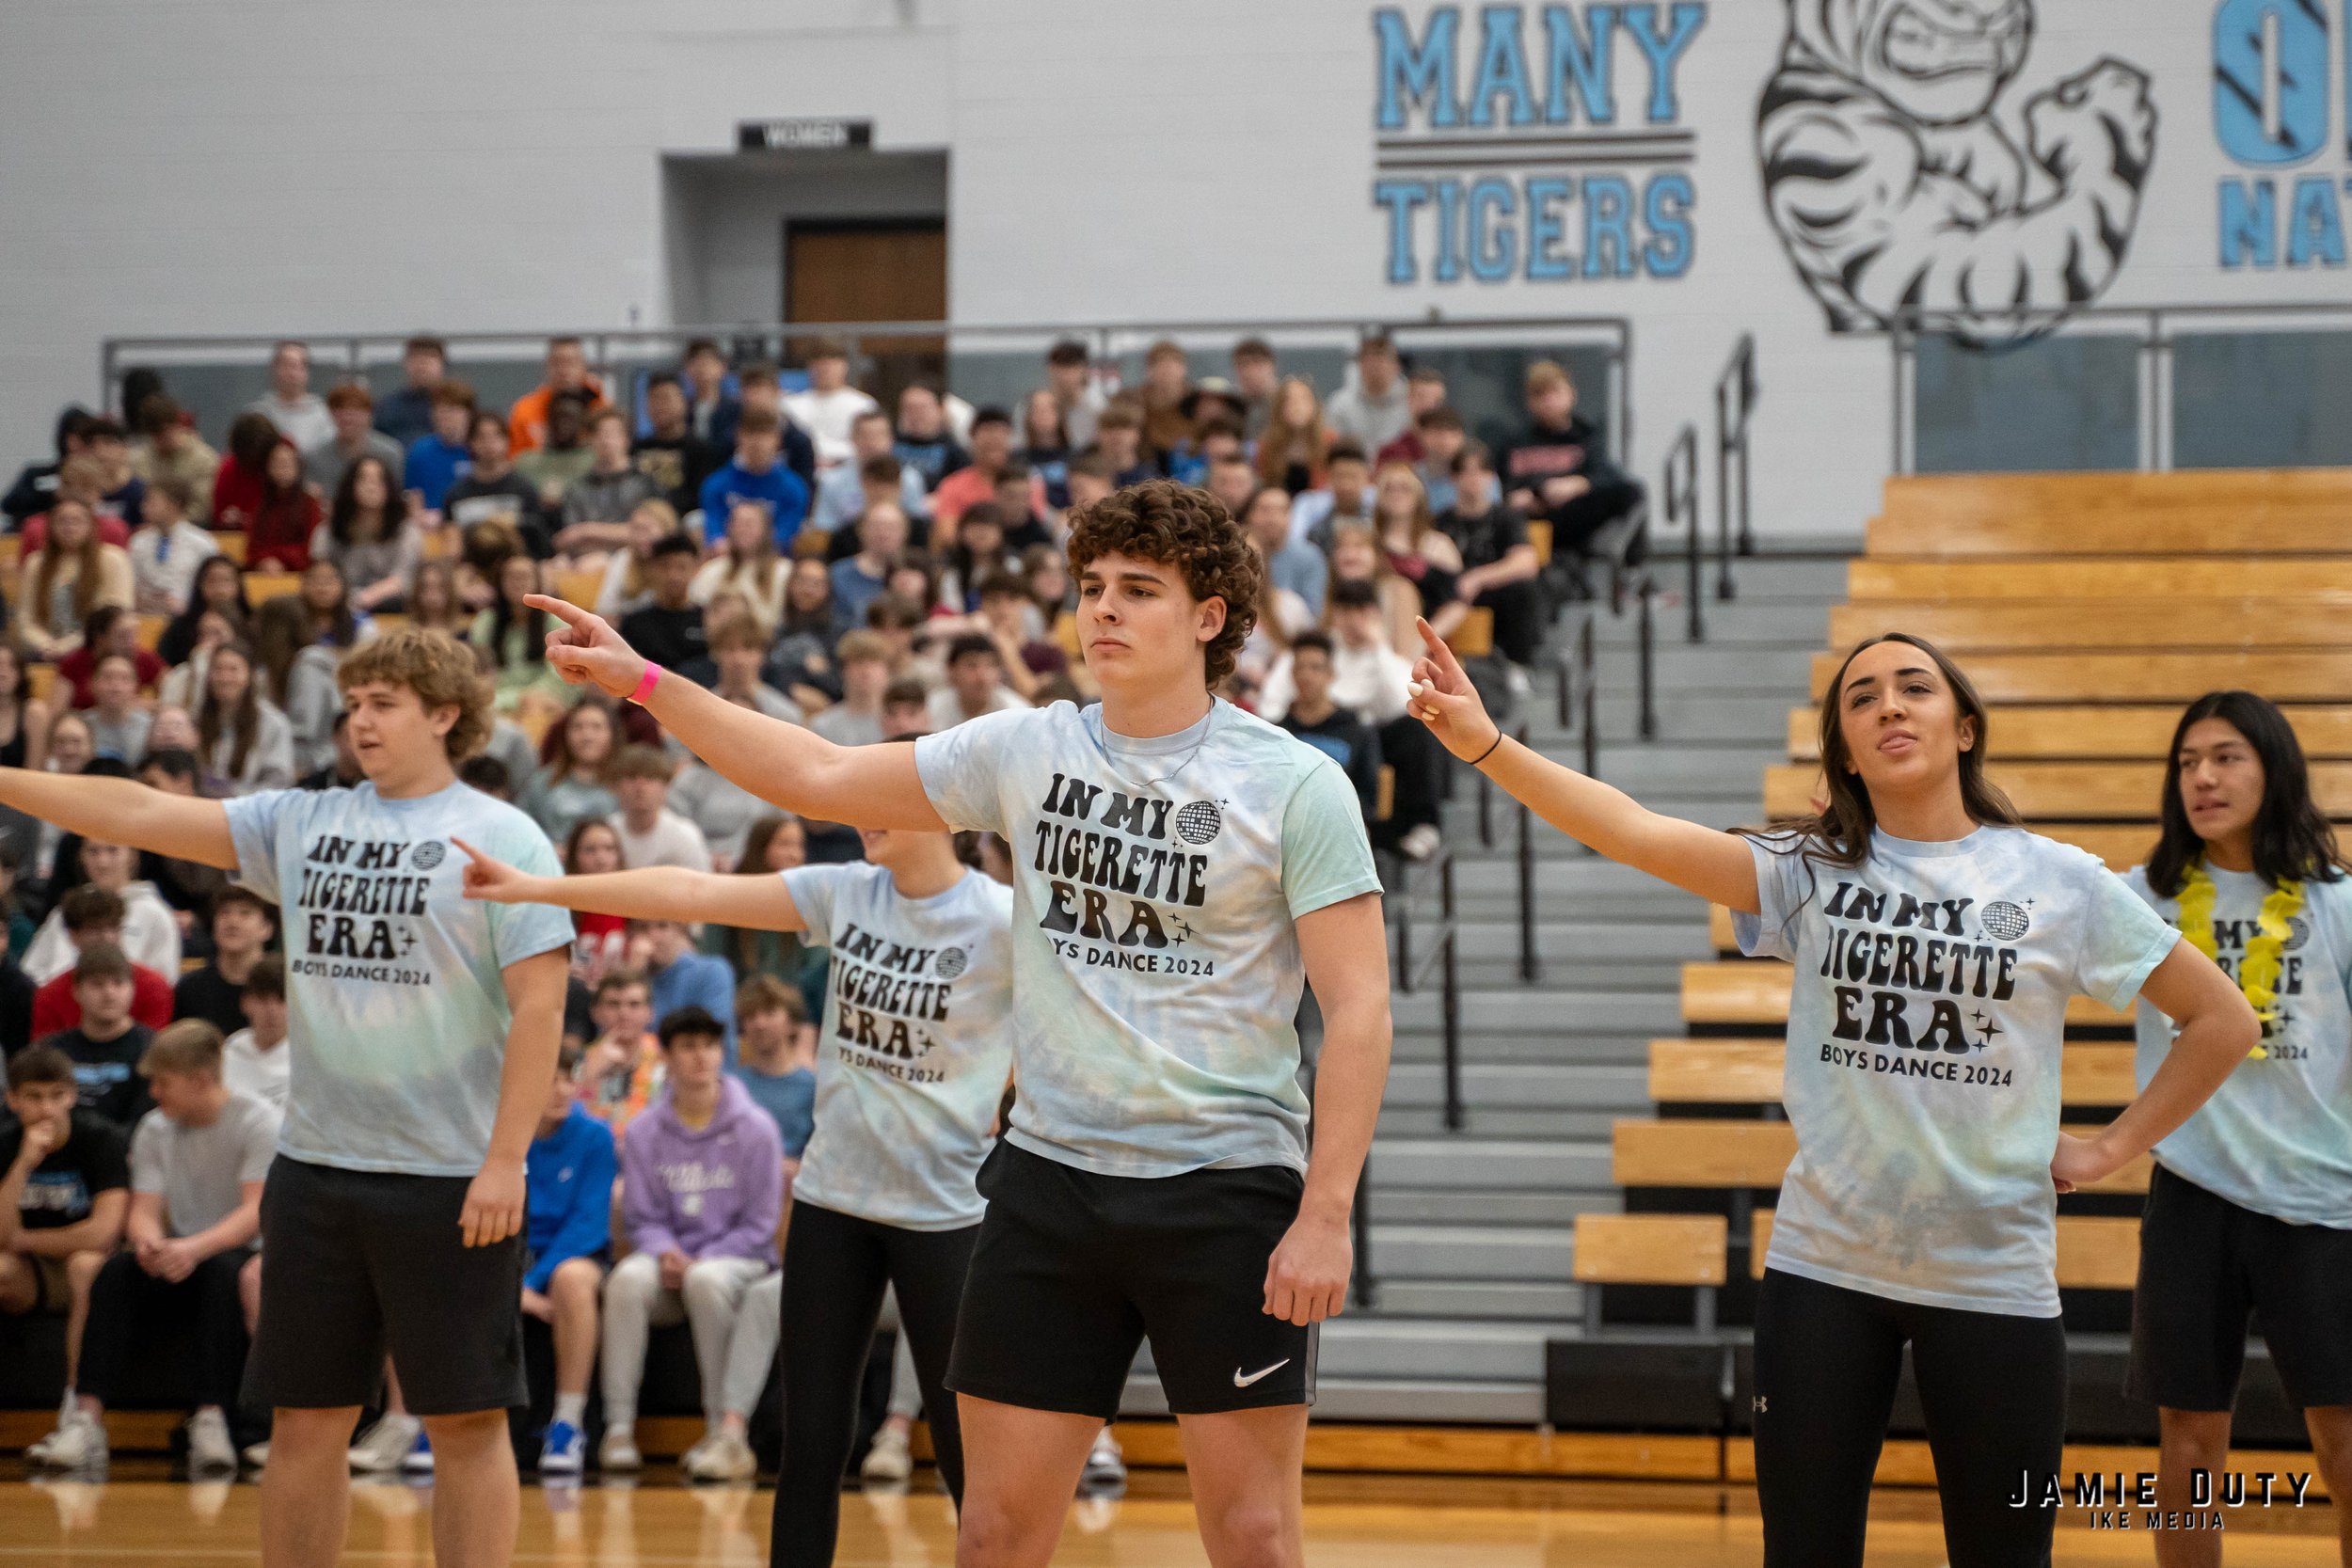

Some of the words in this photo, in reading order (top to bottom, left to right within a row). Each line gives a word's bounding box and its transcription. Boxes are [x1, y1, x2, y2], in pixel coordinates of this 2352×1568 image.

[1373, 2, 1708, 128] MANY
[2211, 0, 2352, 169] O
[1373, 174, 1696, 284] TIGERS
[2217, 175, 2352, 269] NA
[1042, 773, 1104, 820] IN
[1100, 792, 1174, 840] MY
[307, 835, 356, 864] IN
[355, 841, 410, 871] MY
[1034, 819, 1208, 907] TIGERETTE
[307, 913, 397, 960] ERA
[1040, 880, 1168, 948] ERA
[1823, 881, 1887, 924] IN
[1892, 893, 1975, 937] MY
[292, 959, 328, 976] BOYS
[332, 964, 391, 983] DANCE
[394, 970, 432, 987] 2024
[834, 923, 885, 963] IN
[880, 942, 936, 974] MY
[1053, 938, 1079, 959] YS
[1087, 947, 1158, 973] DANCE
[1164, 957, 1214, 977] 2024
[835, 1002, 914, 1060] ERA
[1832, 986, 1970, 1054] ERA
[855, 1053, 904, 1081] DANCE
[907, 1067, 946, 1083] 2024
[1820, 1043, 1868, 1070] BOYS
[1874, 1054, 1959, 1082] DANCE
[1963, 1065, 2013, 1087] 2024
[2274, 1045, 2309, 1060] 2024
